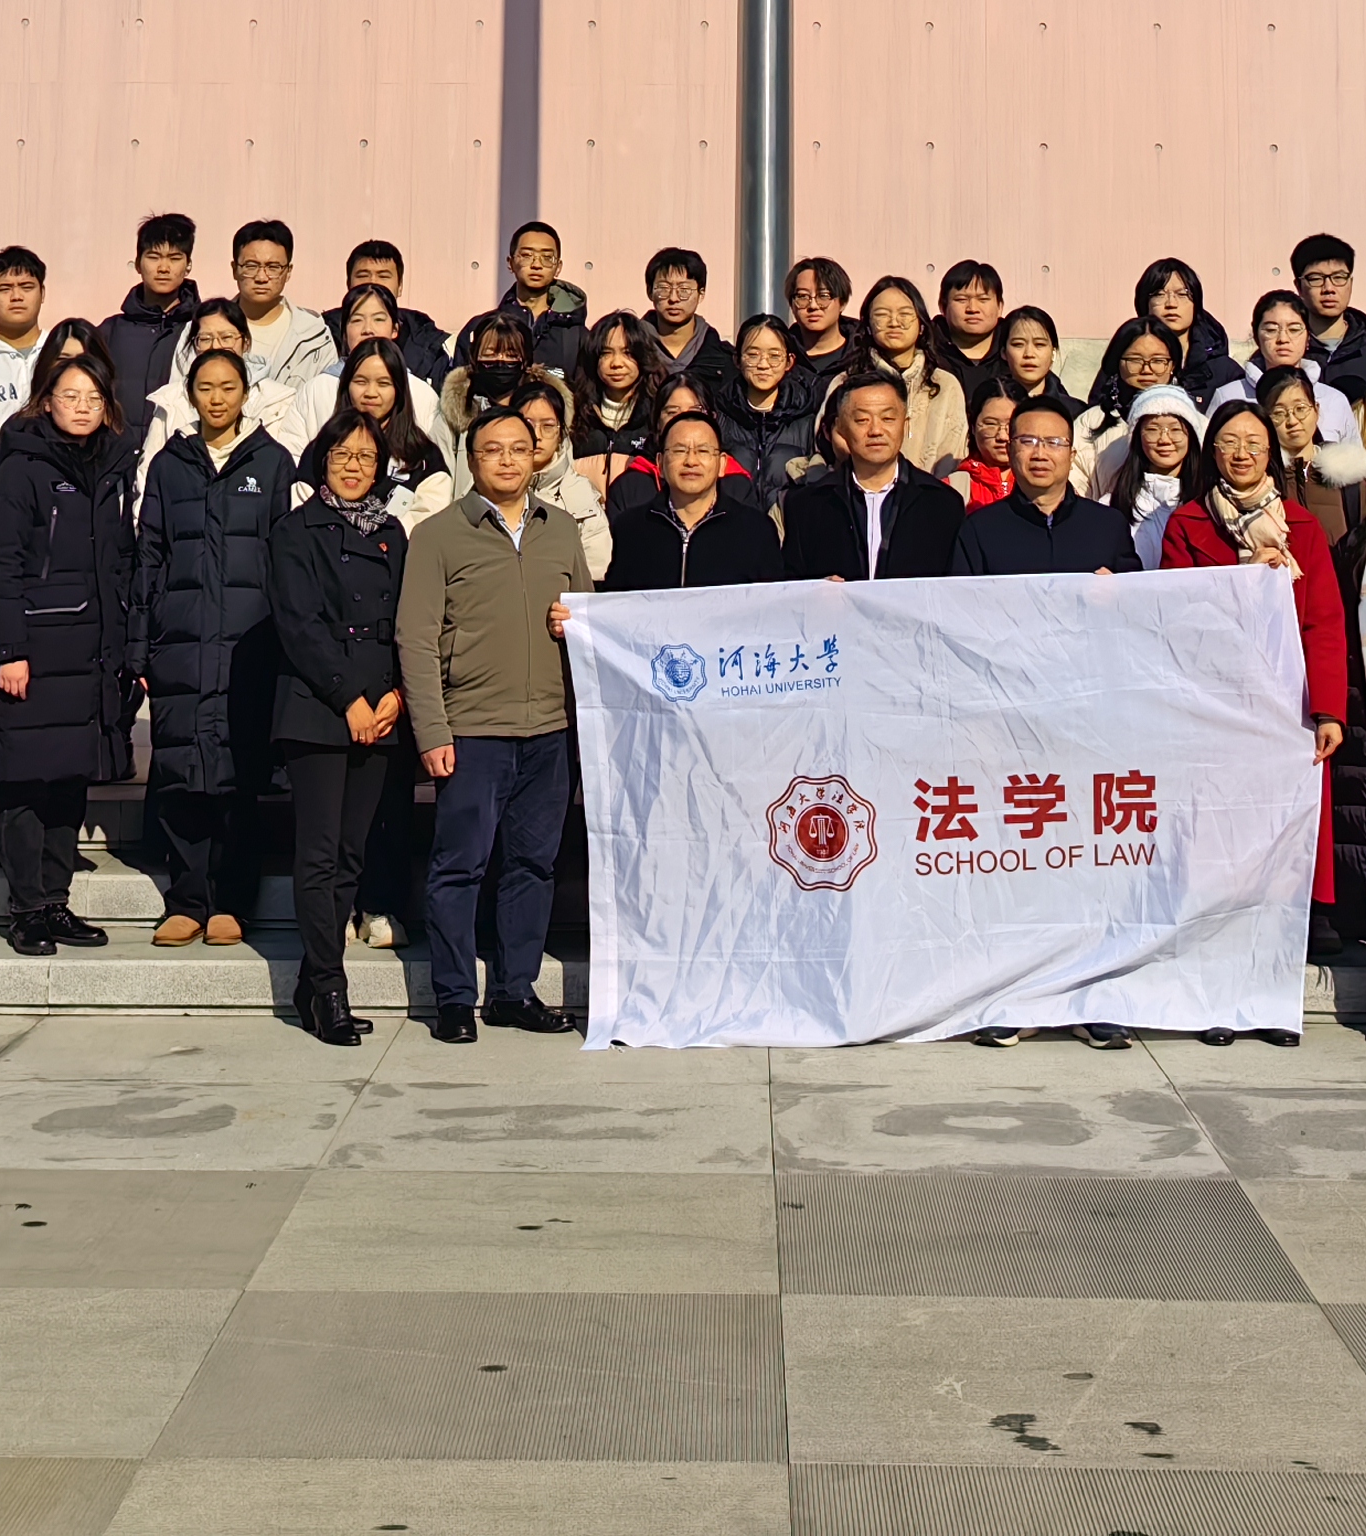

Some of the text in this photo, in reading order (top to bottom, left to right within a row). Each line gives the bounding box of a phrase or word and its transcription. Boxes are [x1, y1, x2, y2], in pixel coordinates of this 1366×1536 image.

[721, 676, 842, 697] HOHAI UNIVERSITY
[912, 768, 1158, 843] 法学院
[915, 843, 1156, 876] SCHOOL OF LAW
